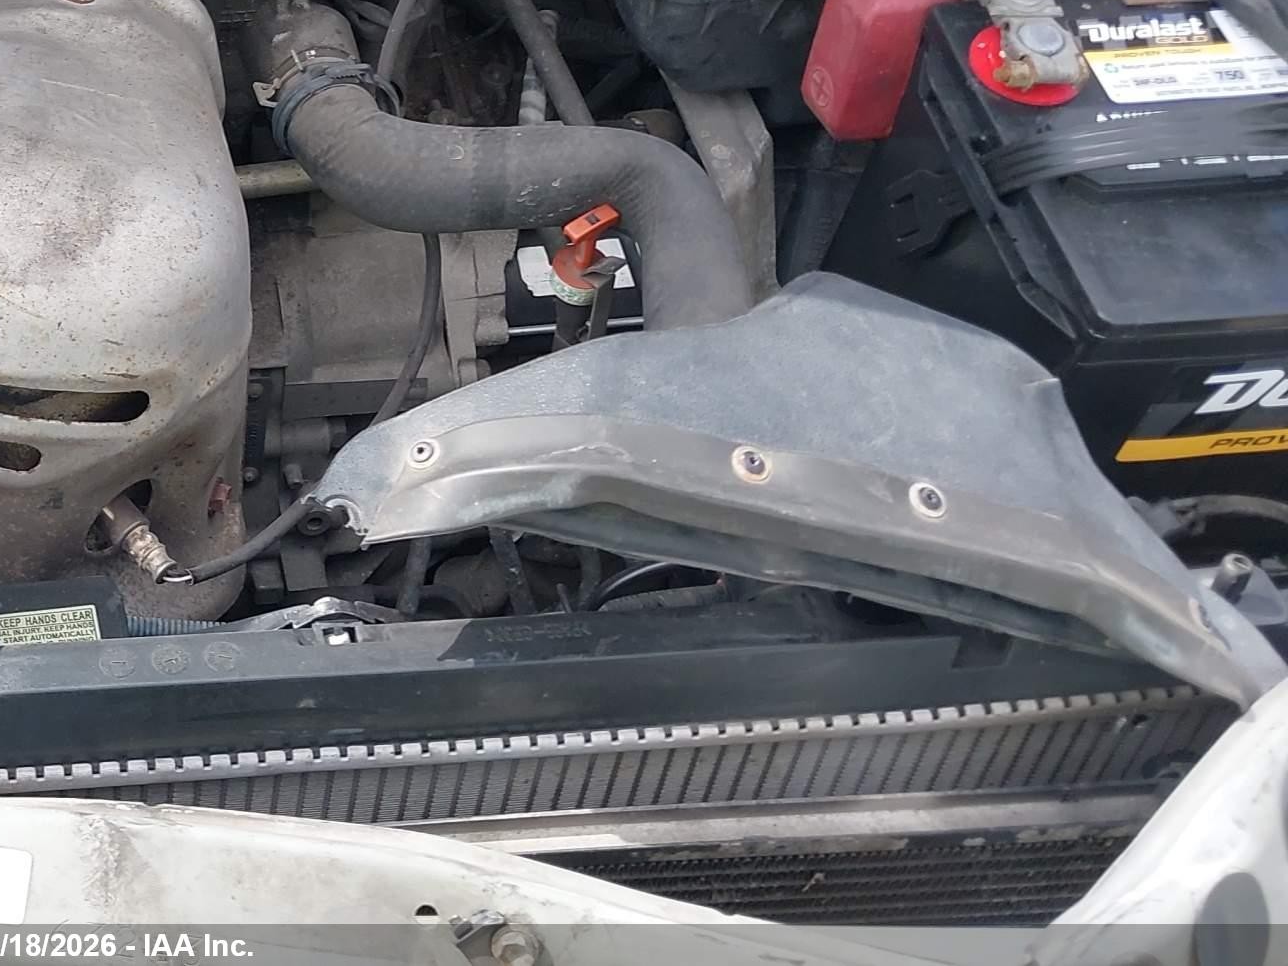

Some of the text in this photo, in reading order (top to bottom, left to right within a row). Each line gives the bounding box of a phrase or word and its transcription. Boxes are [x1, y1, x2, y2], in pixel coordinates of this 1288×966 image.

[1078, 18, 1208, 43] Duralast
[1155, 34, 1210, 46] GOLD
[25, 613, 57, 625] HANDS
[60, 610, 93, 622] CLEAR
[3, 635, 29, 644] START
[30, 627, 96, 642] AUTOMATICALLY
